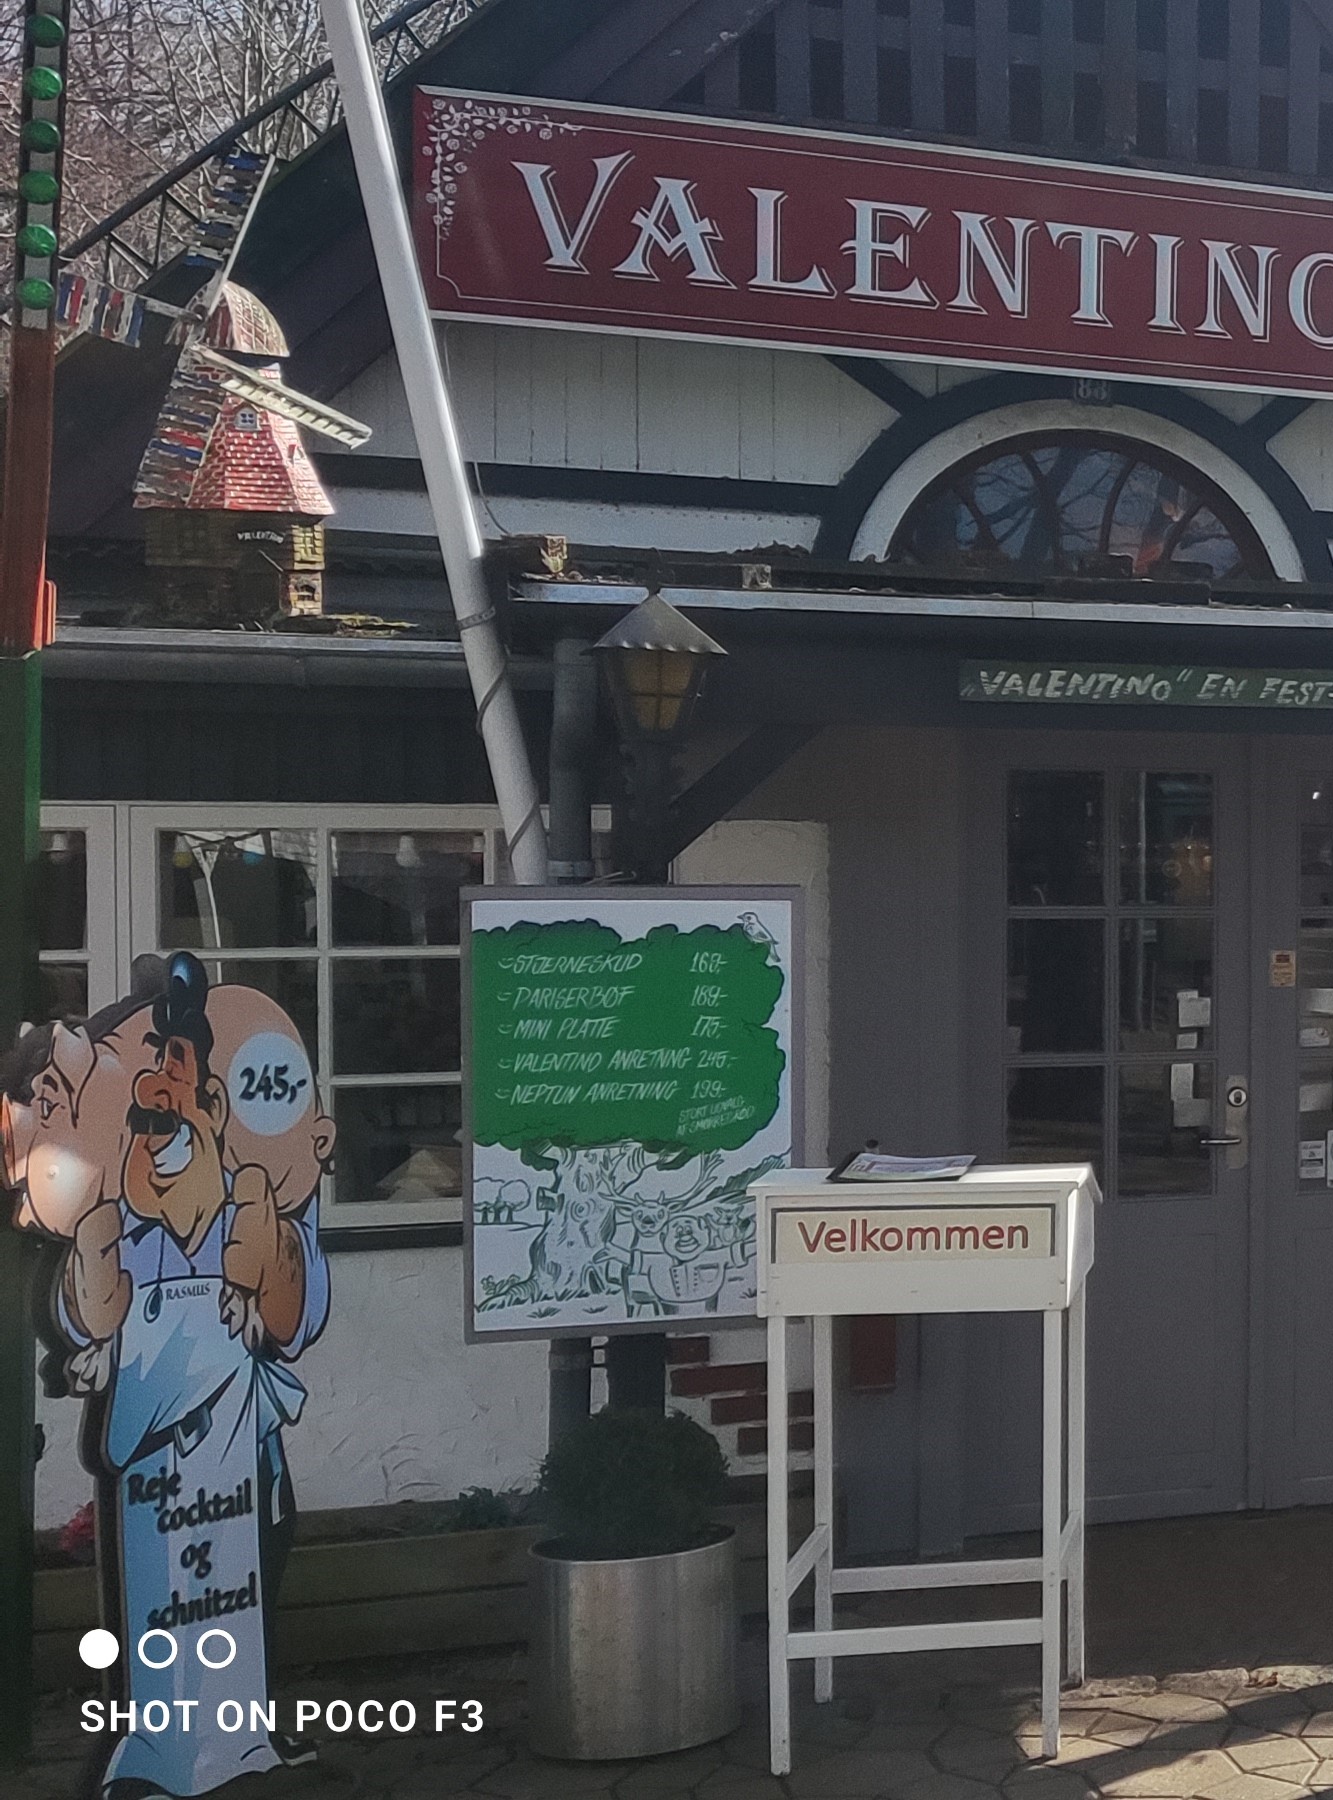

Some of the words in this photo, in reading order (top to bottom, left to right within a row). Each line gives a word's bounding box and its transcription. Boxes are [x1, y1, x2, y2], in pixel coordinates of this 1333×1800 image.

[1196, 673, 1248, 700] EN
[513, 953, 643, 975] STJERNESKUD
[513, 1019, 553, 1040] MINI
[556, 1015, 621, 1041] PLATTE
[513, 1051, 603, 1074] VALENTINO
[510, 1084, 582, 1106] NEPTUN
[583, 1080, 682, 1105] ANRETNING
[797, 1218, 1030, 1254] Velkommen
[165, 1283, 211, 1301] RASMUS
[127, 1466, 181, 1513] Reje
[156, 1477, 253, 1535] cocktail
[180, 1540, 212, 1580] og
[147, 1570, 257, 1632] schnitzel
